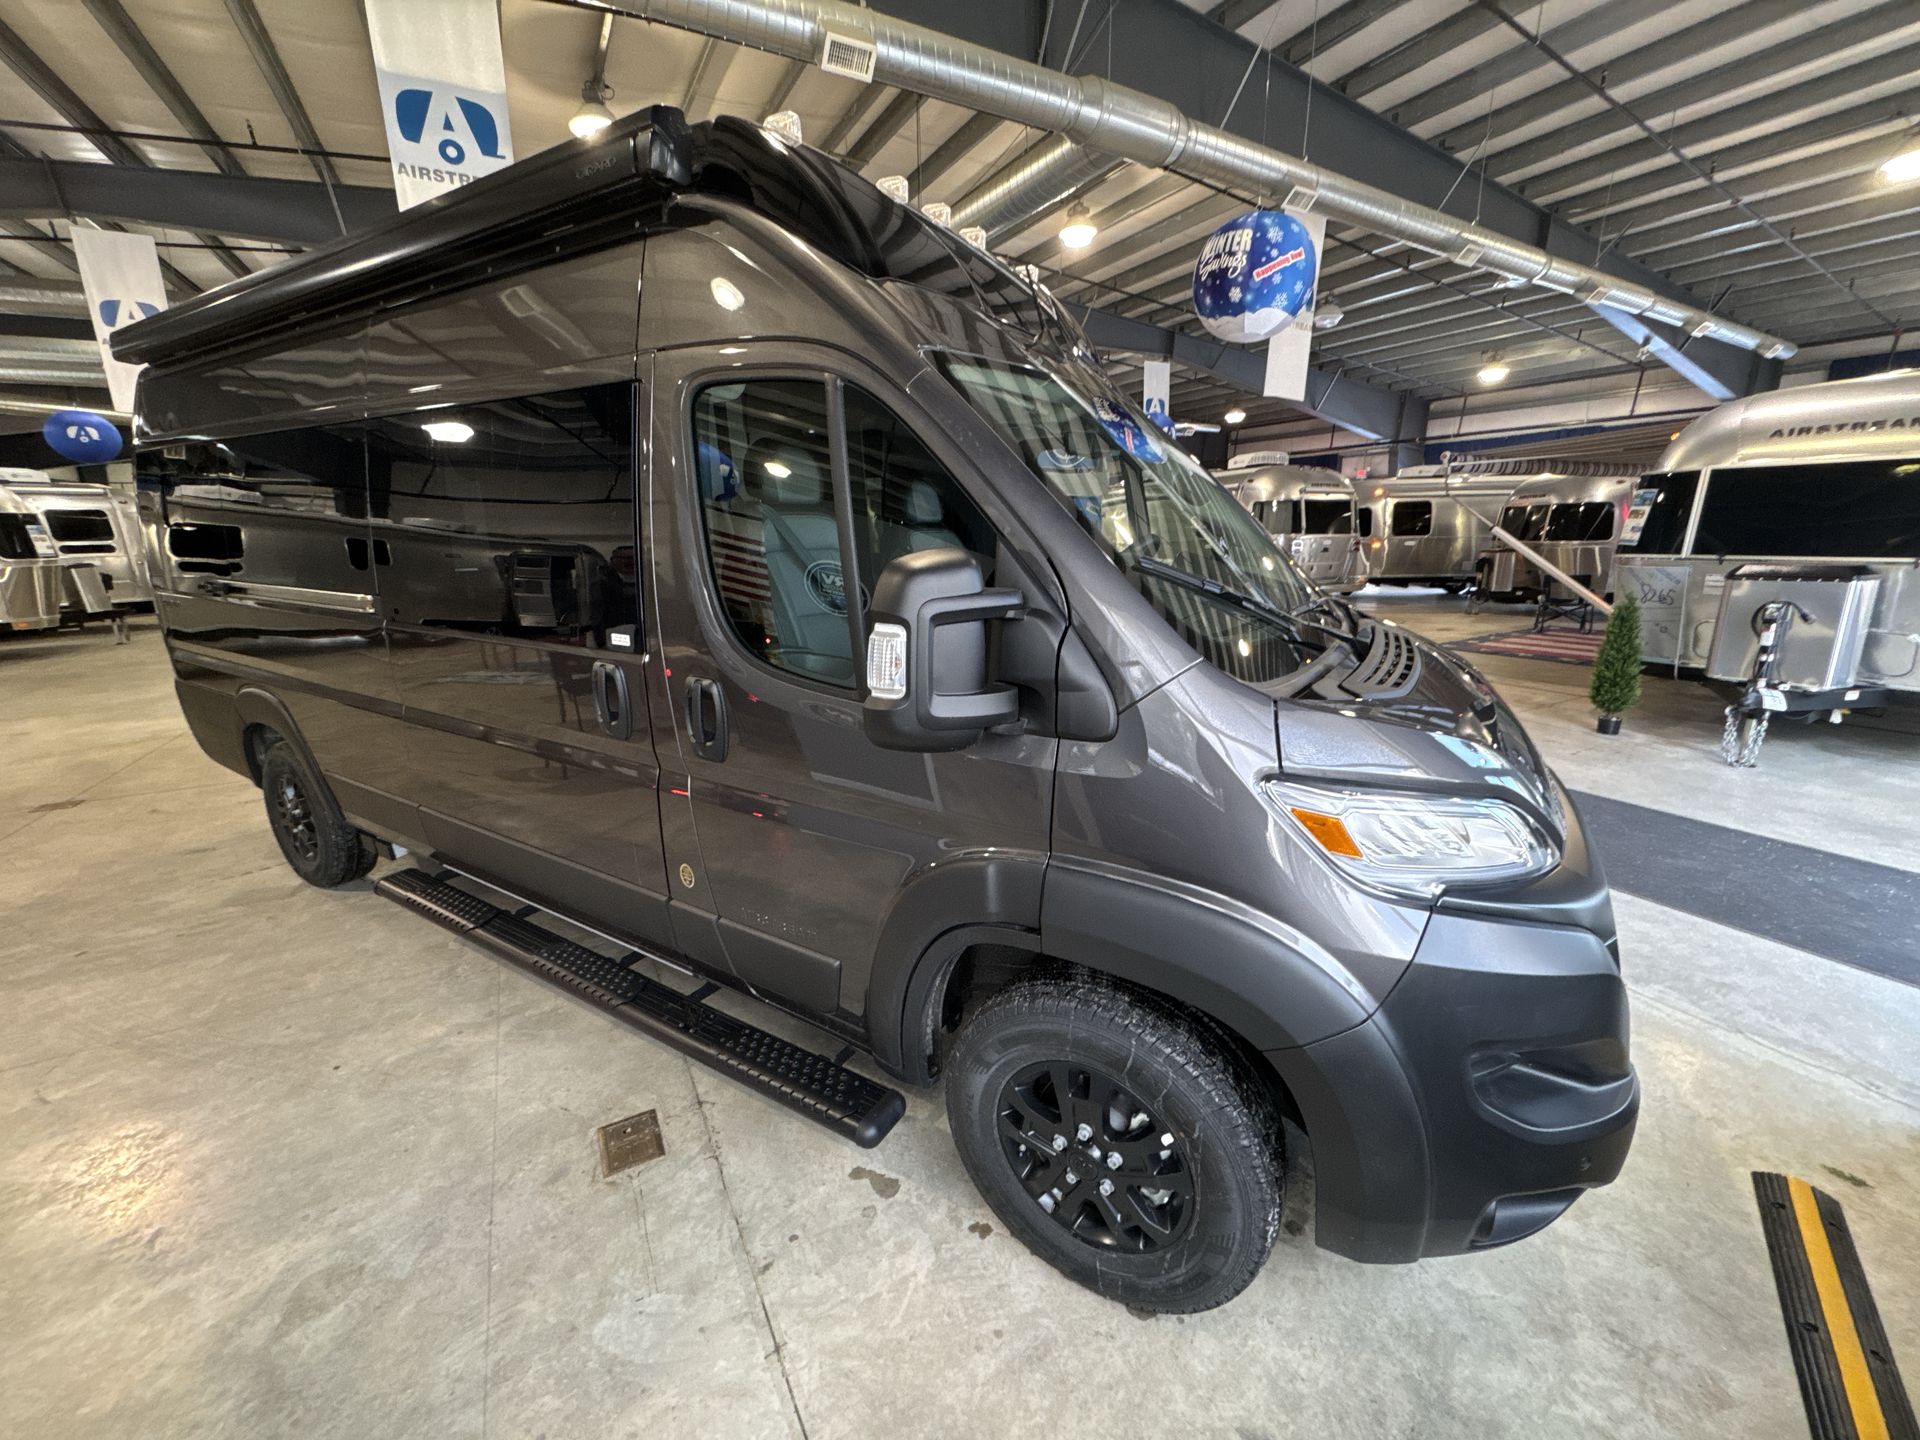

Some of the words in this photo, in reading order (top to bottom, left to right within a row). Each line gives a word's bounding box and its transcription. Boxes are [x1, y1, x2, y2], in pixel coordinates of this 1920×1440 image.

[397, 161, 479, 187] AIRSTR
[1201, 228, 1253, 262] WINTER
[1641, 583, 1676, 606] 8265
